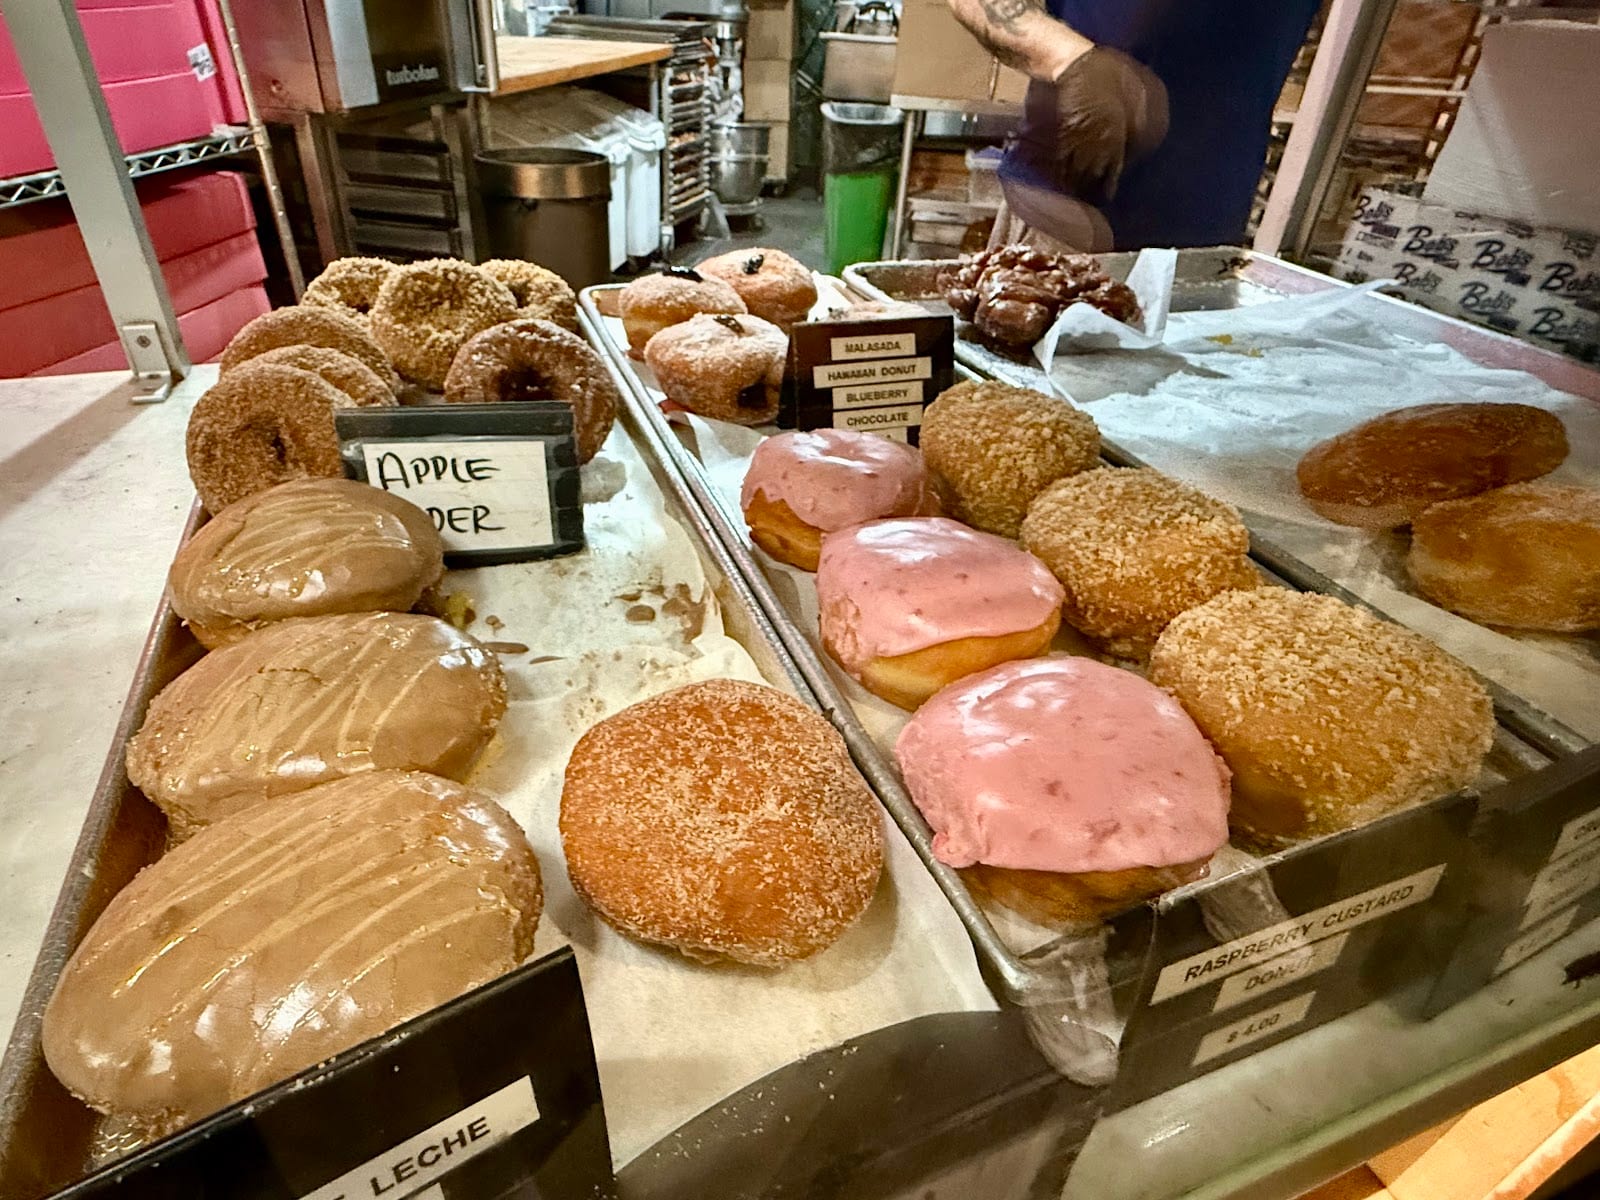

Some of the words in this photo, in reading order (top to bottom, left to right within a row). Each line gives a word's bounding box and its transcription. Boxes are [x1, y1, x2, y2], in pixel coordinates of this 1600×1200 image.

[845, 341, 901, 353] MALASADA
[828, 368, 876, 381] HAWAIIAN
[881, 364, 917, 377] DONUT
[846, 389, 908, 403] BLUEBERRY
[847, 412, 909, 426] CHOCOLATE
[376, 452, 501, 491] APPLE
[426, 505, 506, 534] DER
[1184, 922, 1315, 982] RASPBERRY
[1322, 885, 1414, 929] CUSTARD
[1245, 953, 1317, 990] DONUT
[370, 1116, 491, 1196] LECHE
